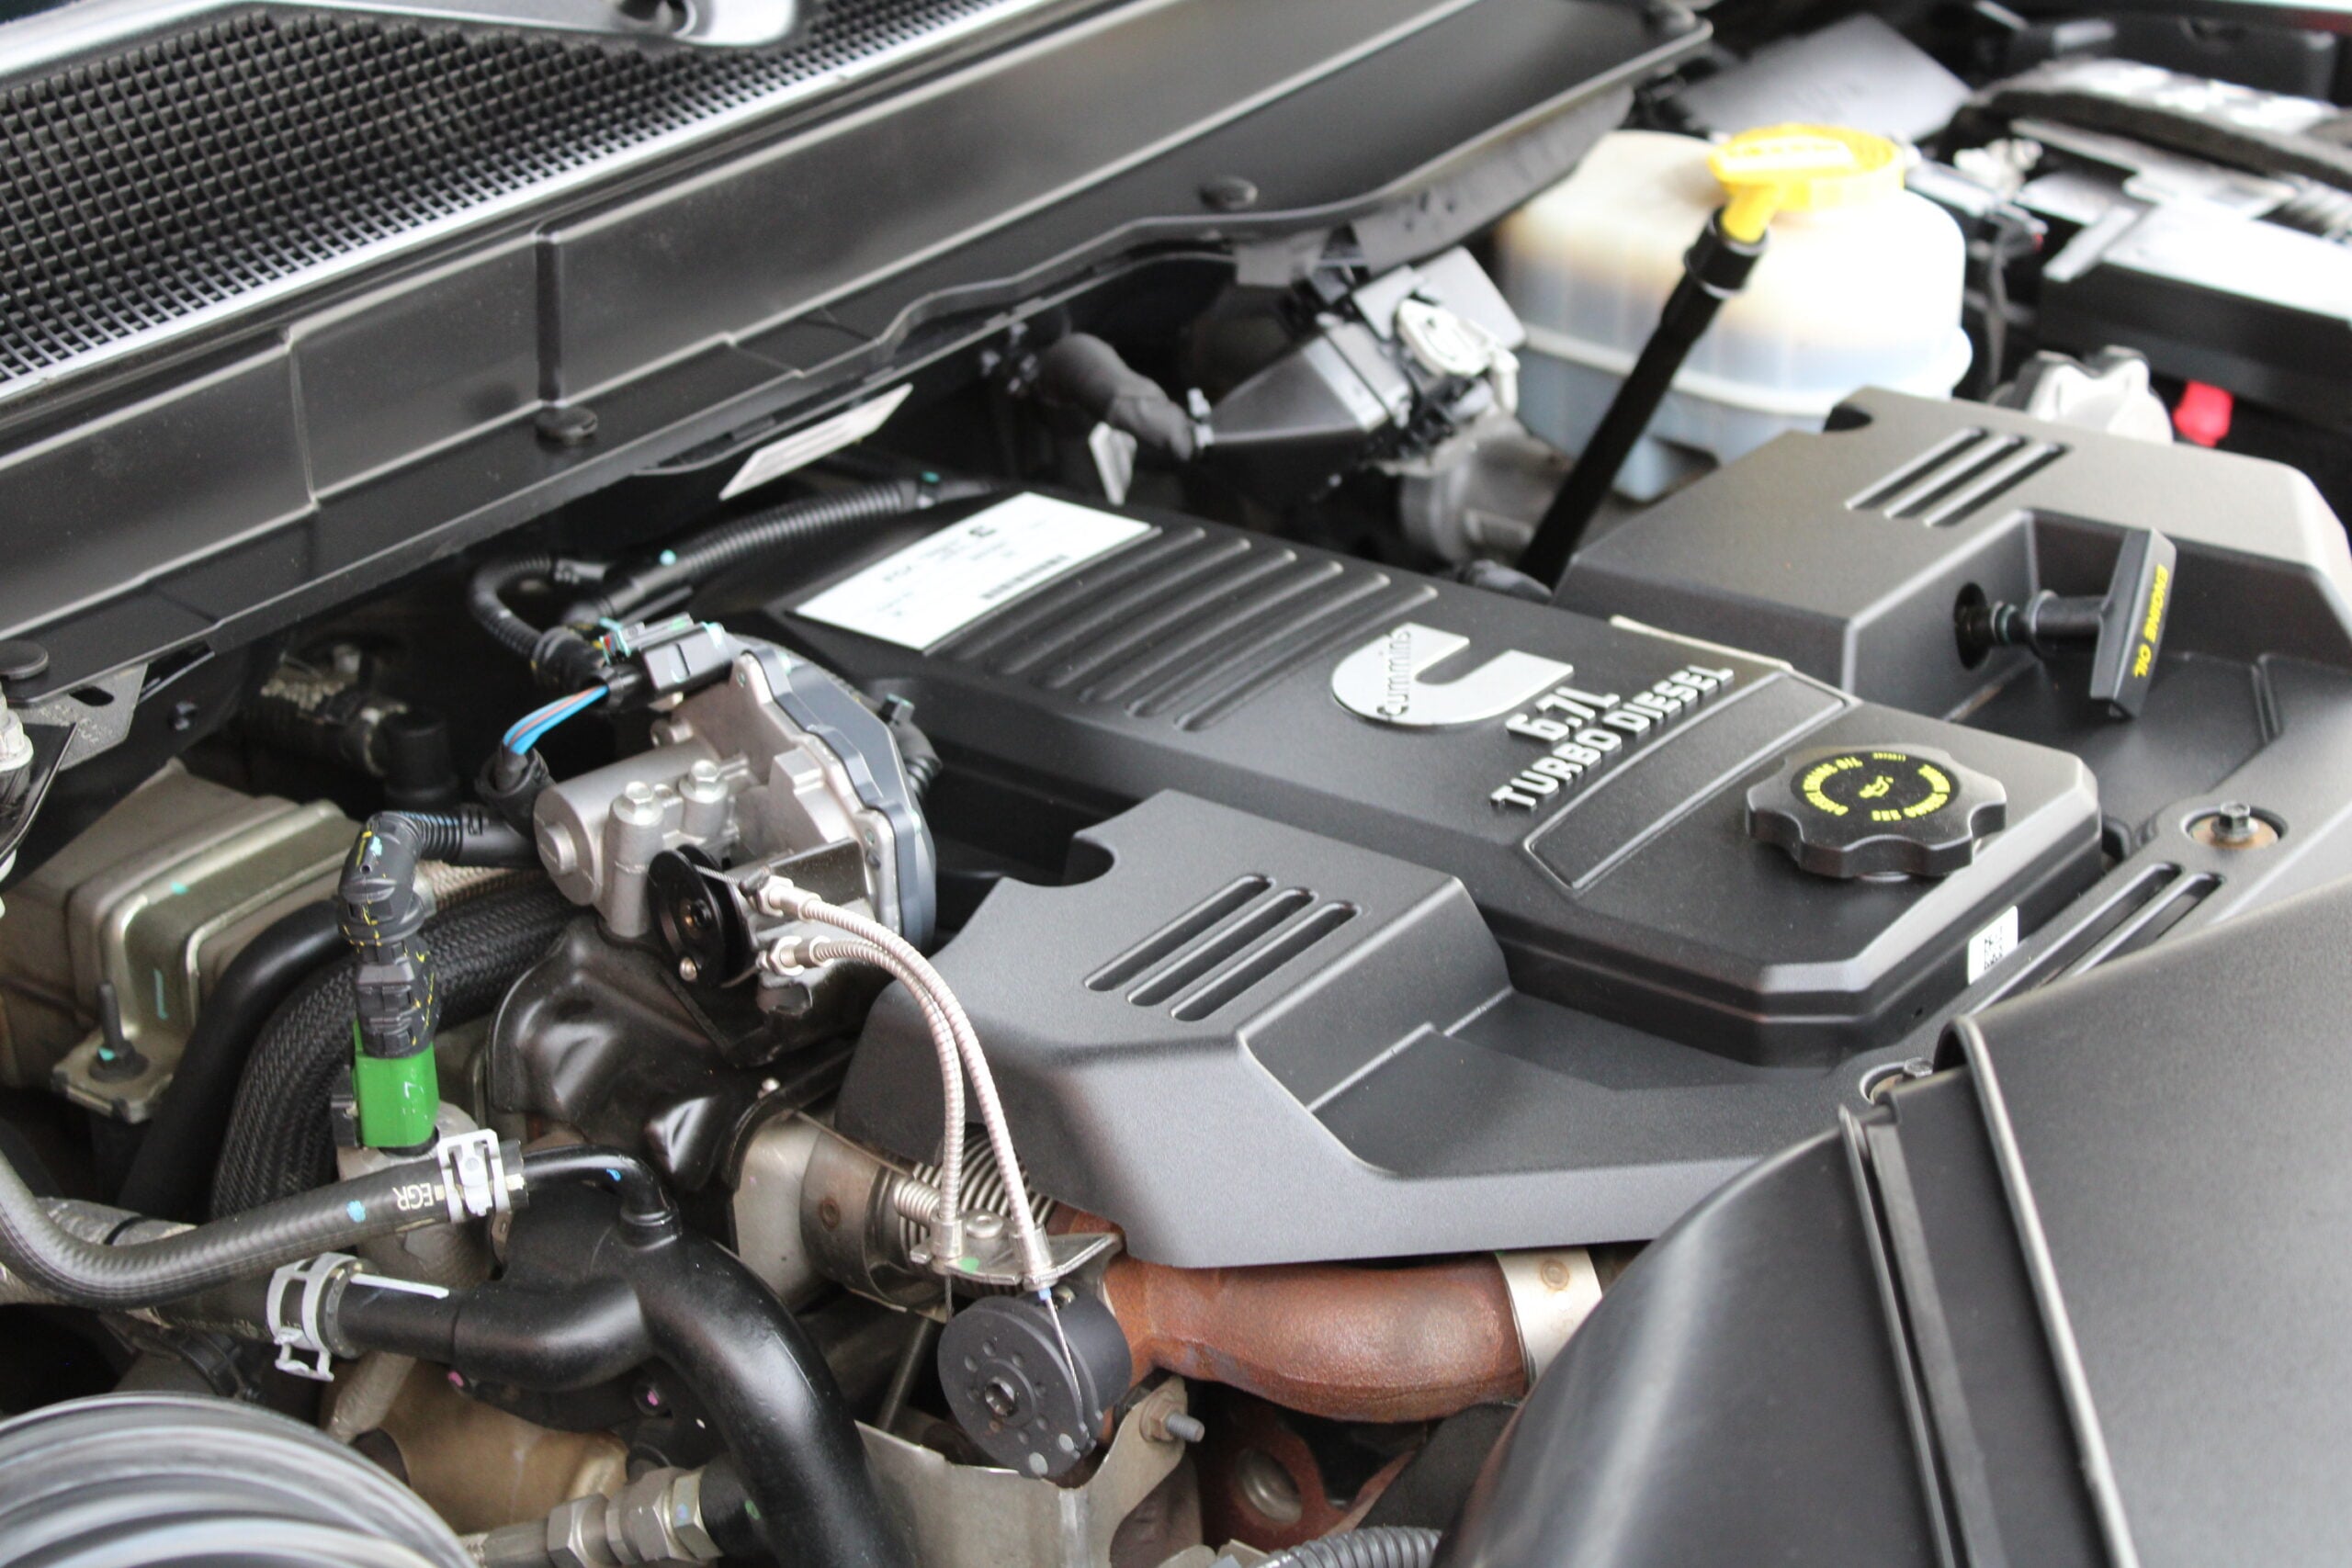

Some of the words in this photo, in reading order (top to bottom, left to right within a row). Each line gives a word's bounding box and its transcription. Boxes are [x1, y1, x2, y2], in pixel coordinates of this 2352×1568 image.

[1376, 631, 1411, 716] Cummins
[2132, 644, 2152, 678] OIL
[1490, 727, 1622, 809] TURBO
[1603, 664, 1735, 736] DIESEL
[1506, 686, 1620, 742] 6.7L
[392, 1183, 434, 1211] EGR
